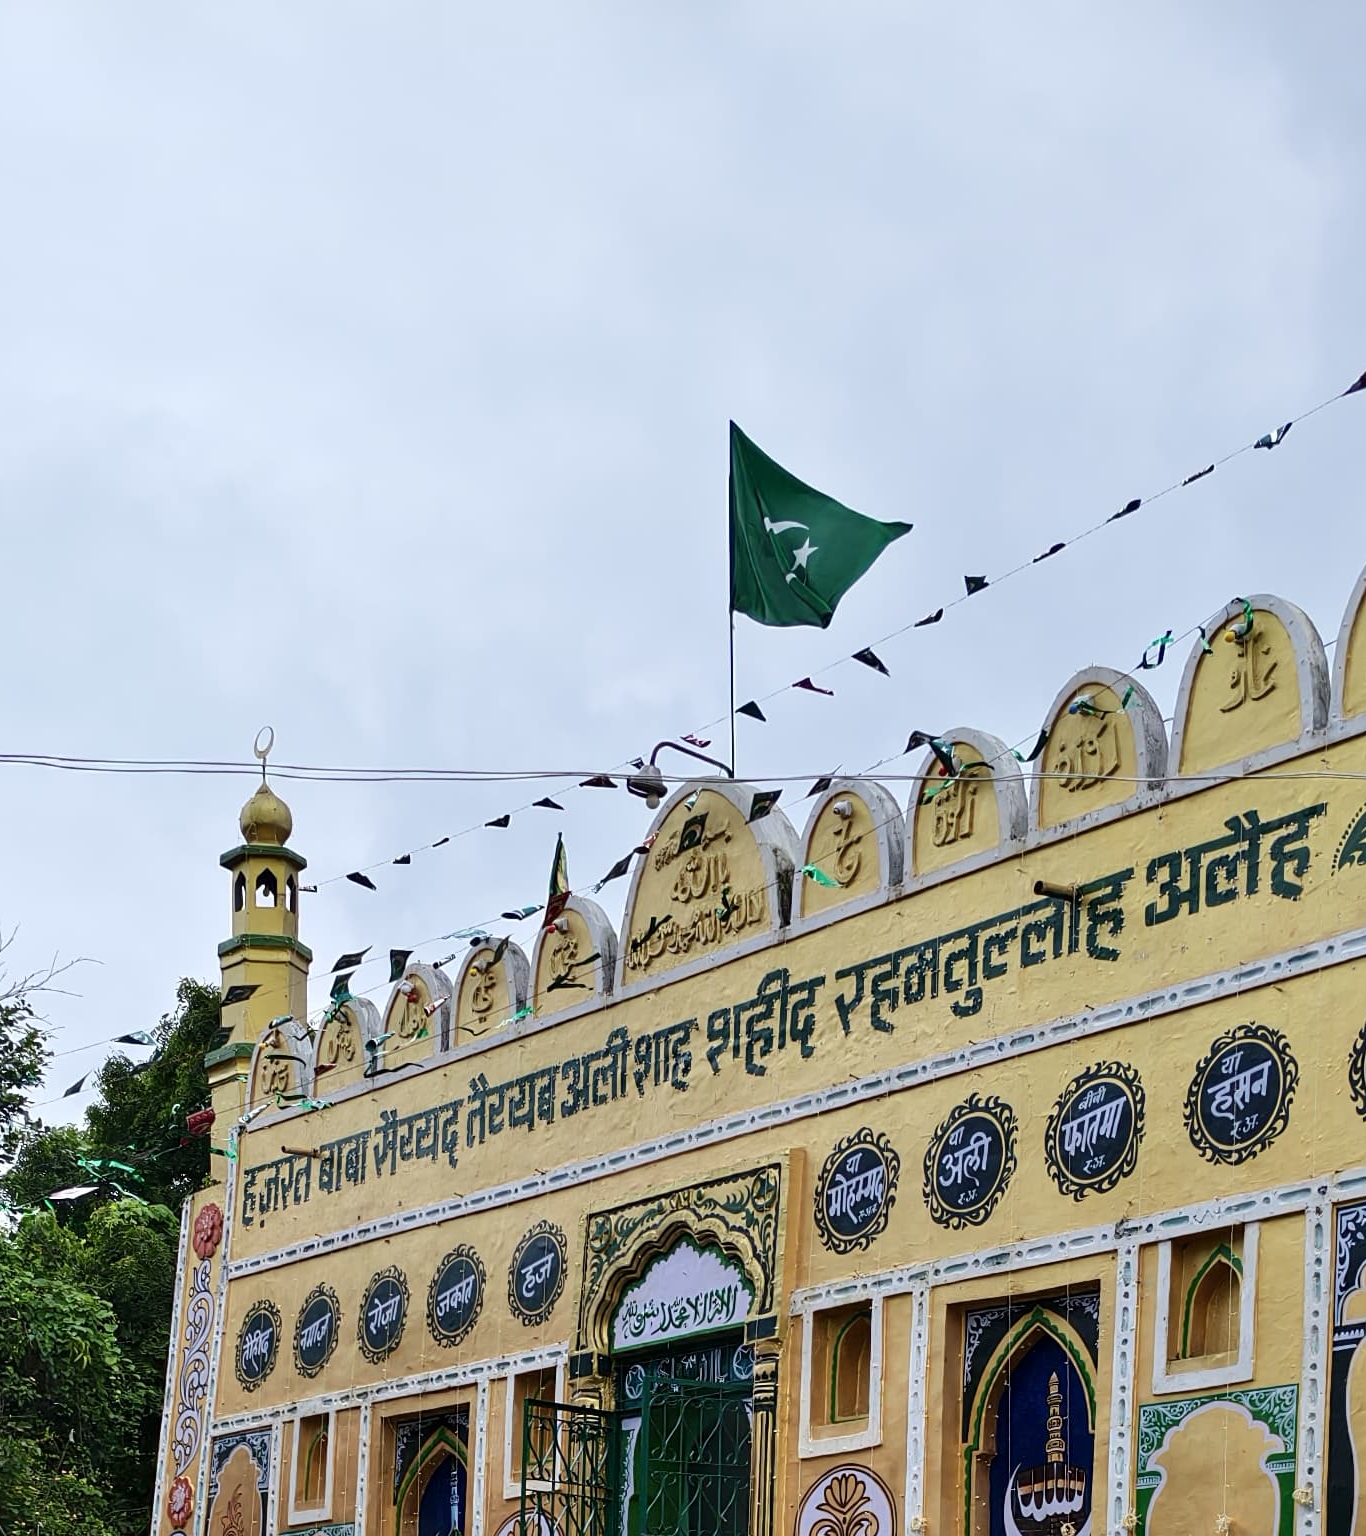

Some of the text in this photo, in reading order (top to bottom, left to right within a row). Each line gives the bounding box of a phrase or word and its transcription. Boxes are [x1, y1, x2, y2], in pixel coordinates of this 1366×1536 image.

[319, 1130, 371, 1194] बाबा
[561, 1026, 632, 1118] अली
[634, 1018, 699, 1098] शाह
[706, 967, 826, 1077] शहीद
[1221, 1050, 1242, 1075] या
[1078, 1086, 1107, 1111] बीबी
[1207, 1060, 1272, 1120] हसन
[949, 1126, 966, 1146] या
[1062, 1096, 1127, 1156] फातमा
[846, 1152, 863, 1175] या
[939, 1131, 993, 1187] अली
[827, 1164, 884, 1225] मोहम्मद
[437, 1274, 475, 1321] ज़कात
[520, 1252, 555, 1298] हज
[300, 1313, 332, 1351] नमाज़
